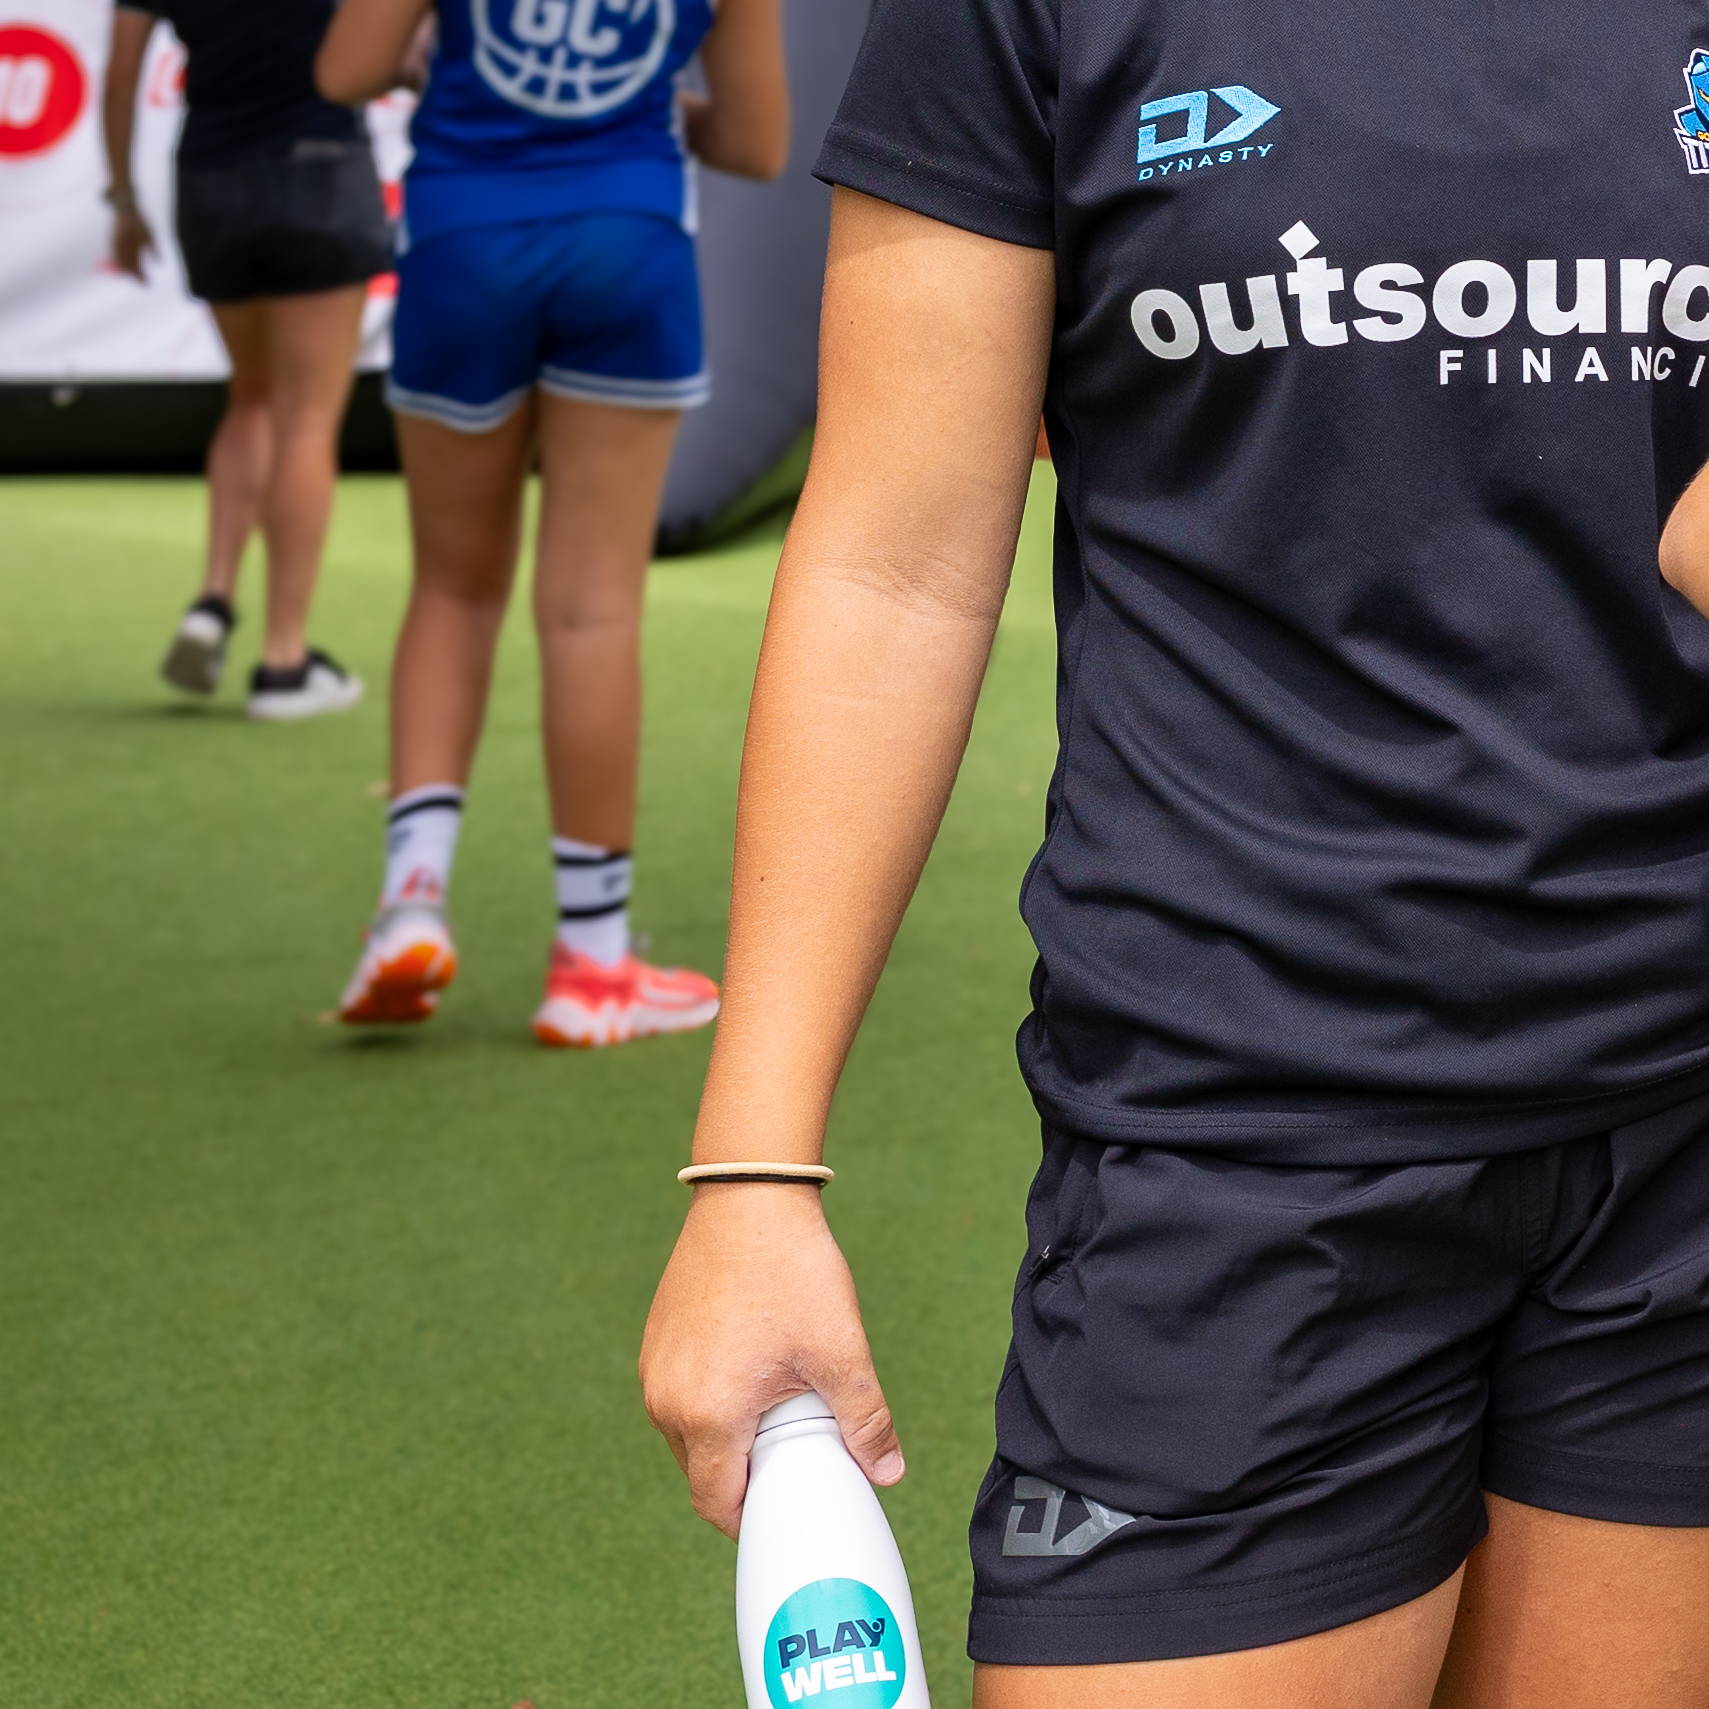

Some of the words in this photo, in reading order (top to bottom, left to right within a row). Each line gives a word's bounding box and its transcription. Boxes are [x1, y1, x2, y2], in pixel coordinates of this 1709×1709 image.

[1138, 143, 1274, 181] DYNASTY
[778, 1617, 885, 1669] PLAY
[781, 1651, 896, 1704] WELL
